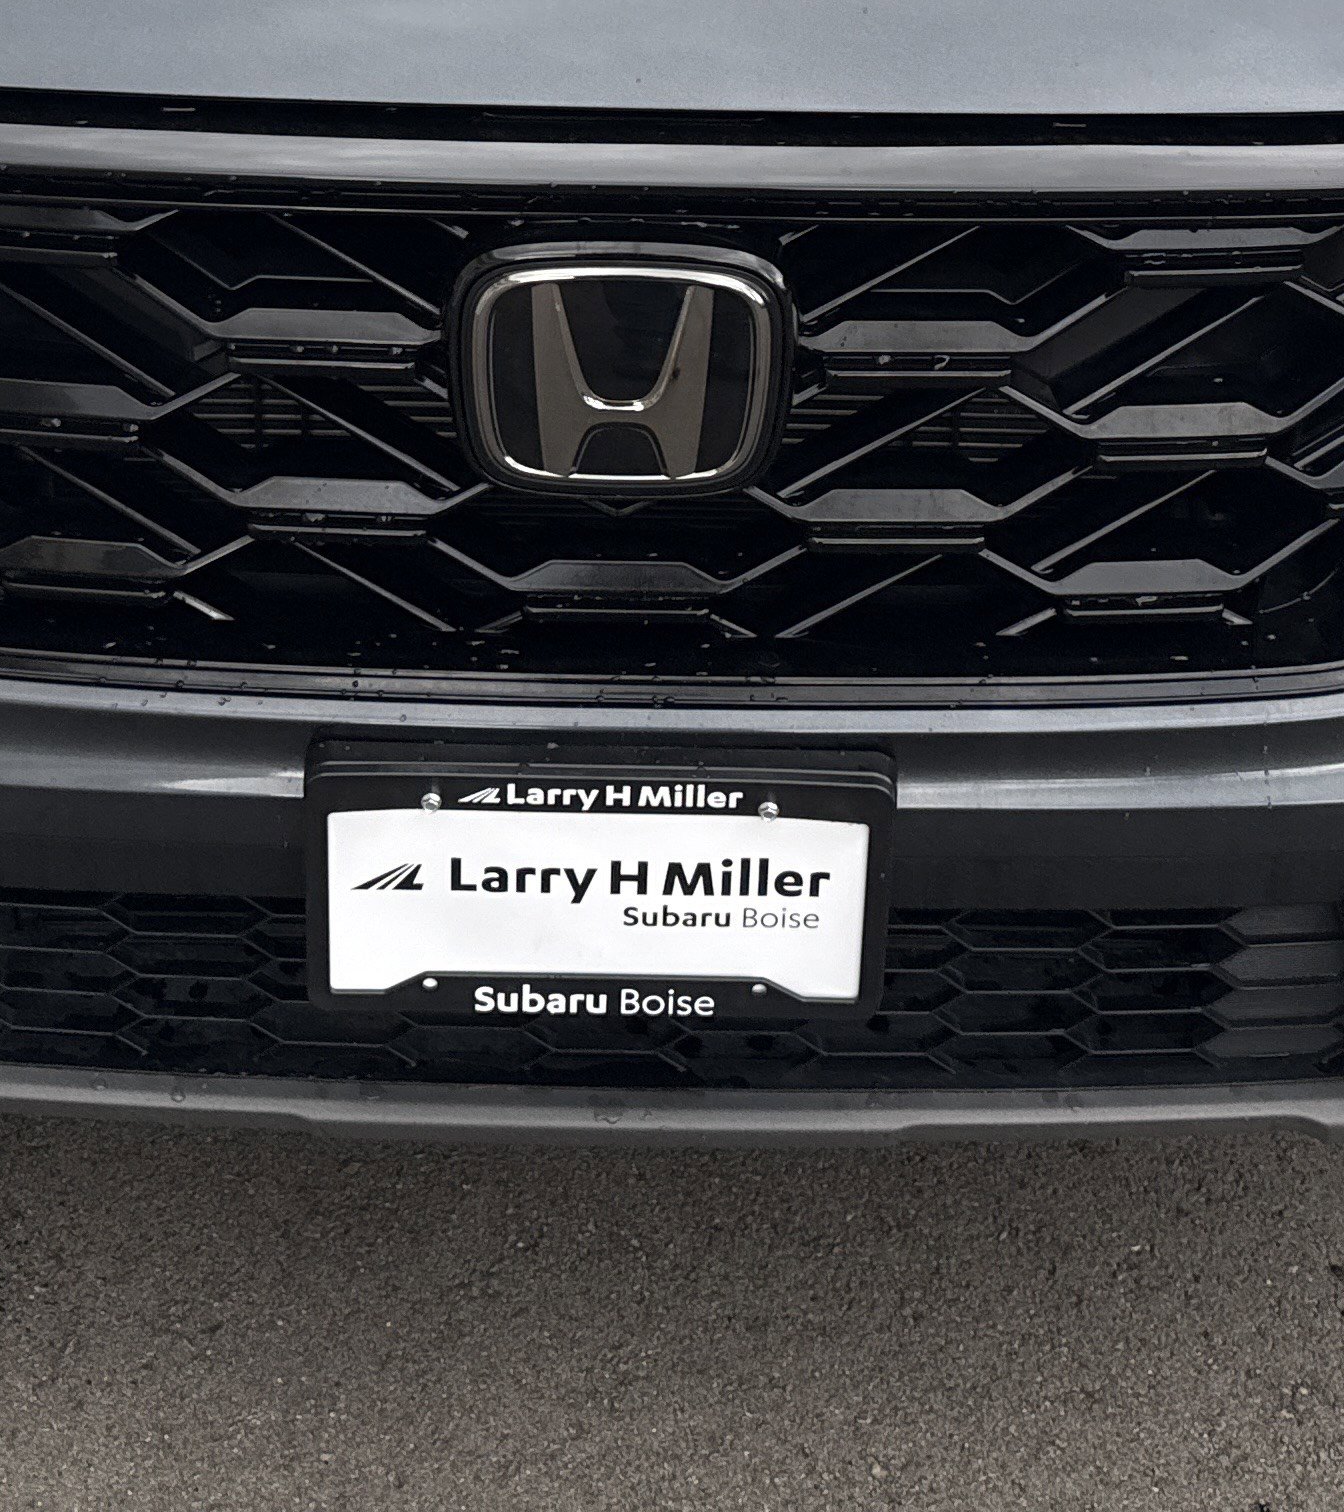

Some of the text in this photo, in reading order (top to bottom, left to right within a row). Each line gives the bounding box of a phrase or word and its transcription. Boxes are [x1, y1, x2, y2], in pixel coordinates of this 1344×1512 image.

[506, 782, 744, 812] Larry H Miller
[450, 857, 831, 904] Larry H Miller
[623, 904, 821, 929] Subaru Boise
[474, 983, 716, 1016] Subaru Boise
